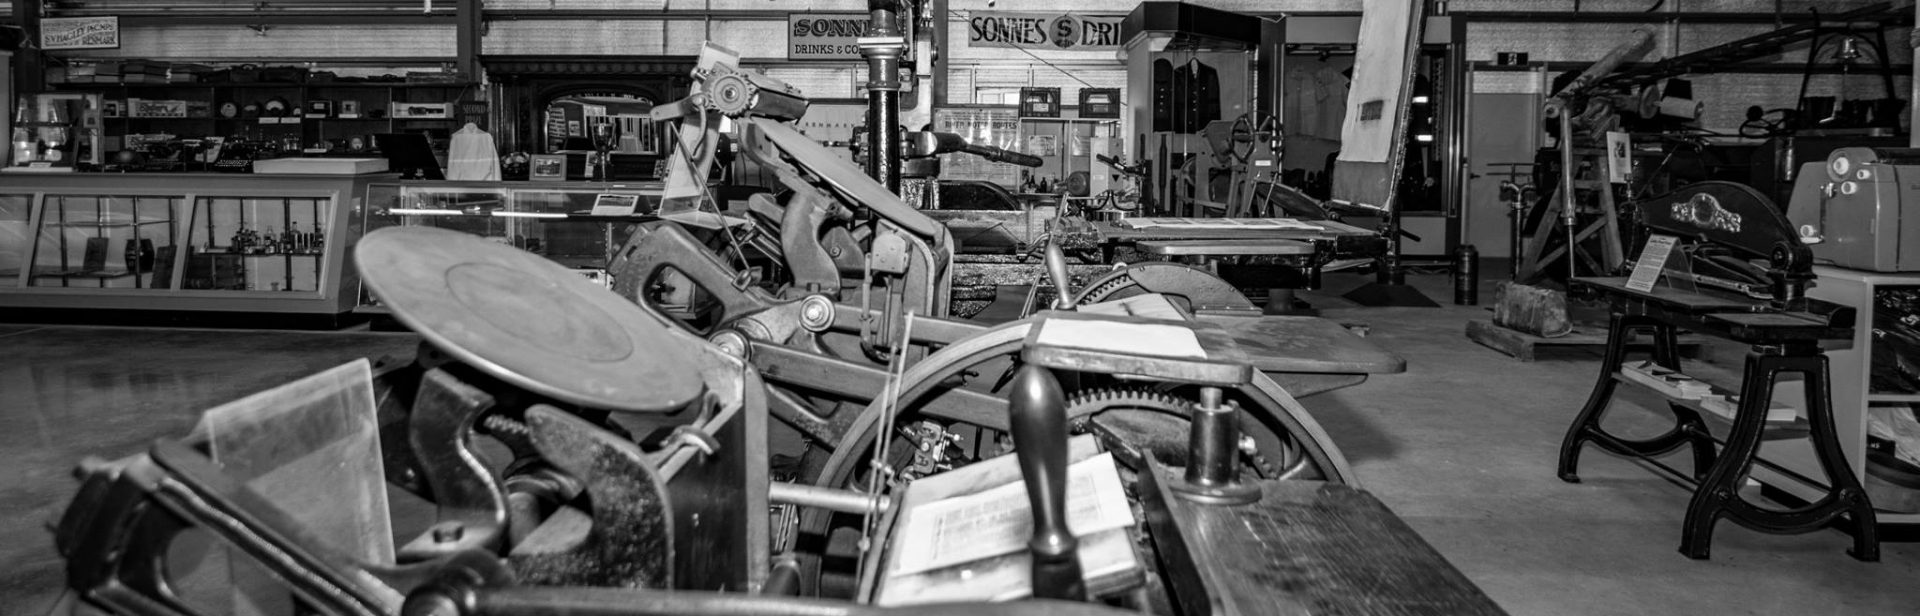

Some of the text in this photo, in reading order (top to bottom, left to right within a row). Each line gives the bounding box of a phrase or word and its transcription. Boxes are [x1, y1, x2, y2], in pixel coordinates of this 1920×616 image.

[972, 17, 1047, 44] SONNES
[1057, 20, 1072, 37] S
[795, 45, 834, 54] DRINKS
[837, 46, 843, 54] &
